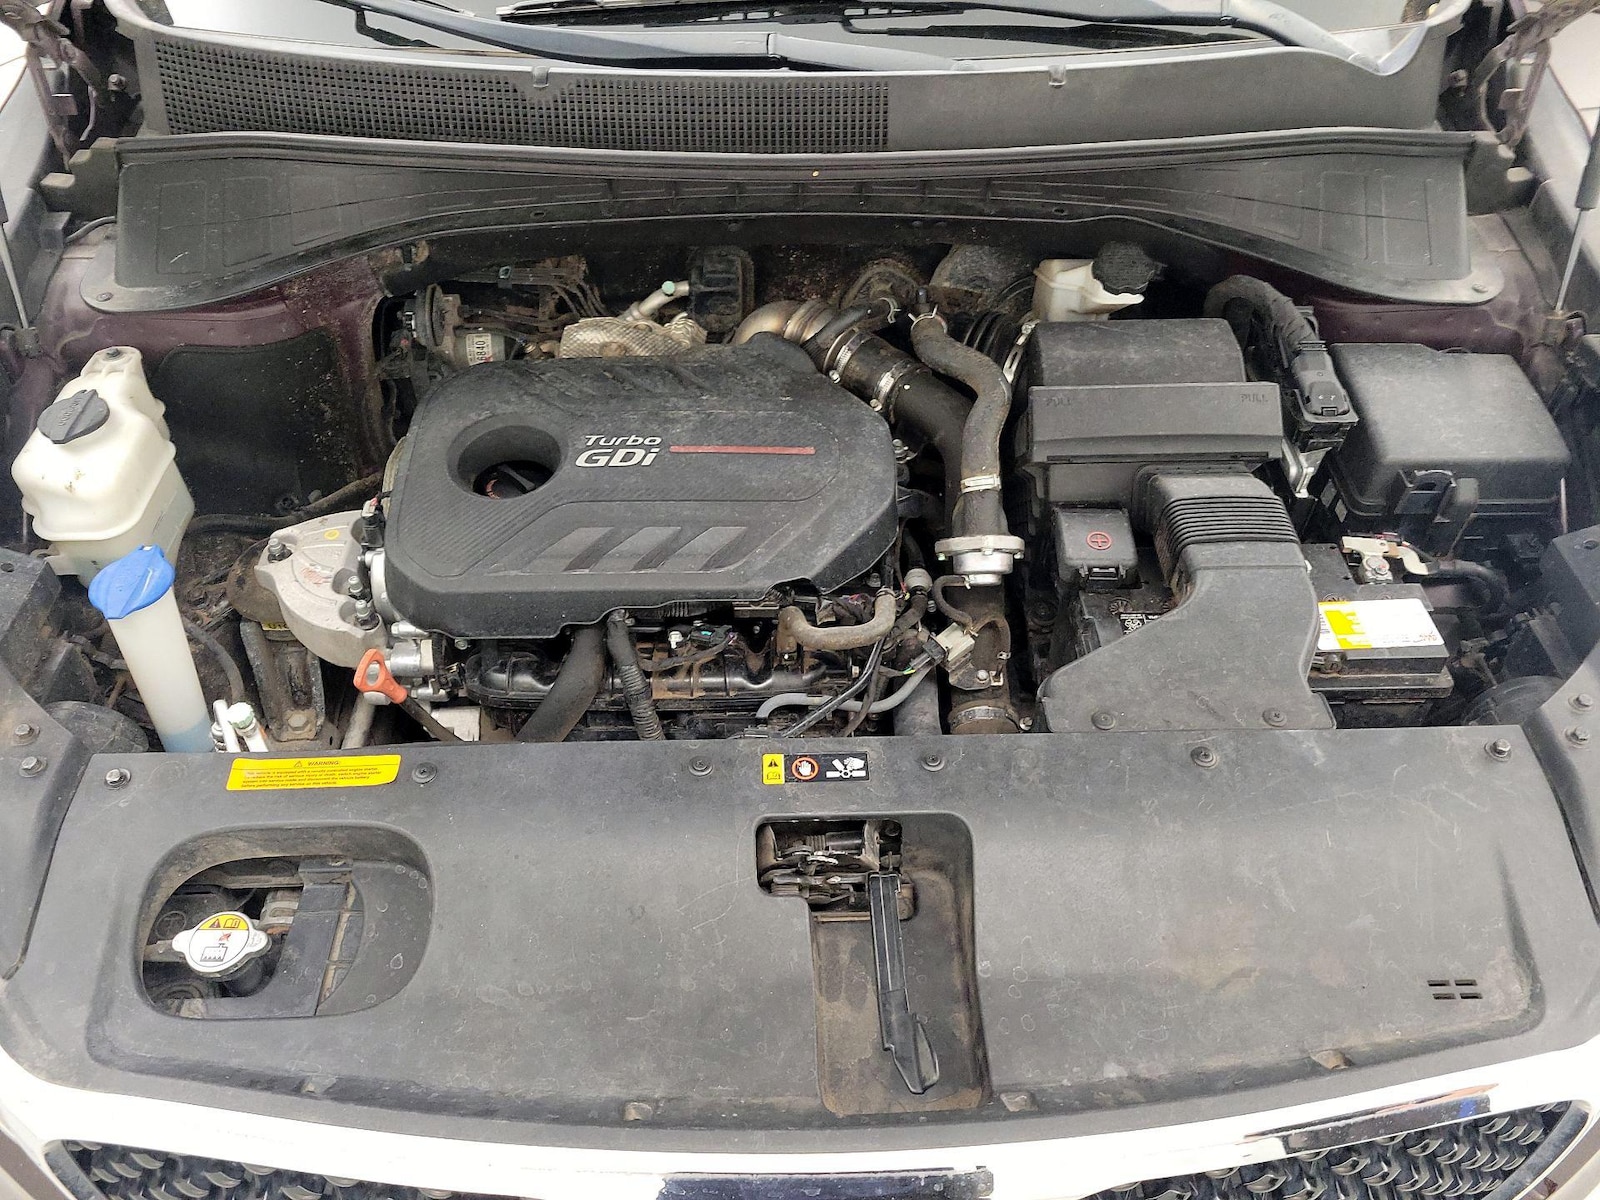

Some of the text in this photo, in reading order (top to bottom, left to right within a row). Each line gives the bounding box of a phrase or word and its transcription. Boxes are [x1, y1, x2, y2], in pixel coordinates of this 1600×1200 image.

[1240, 393, 1269, 403] PULL
[585, 434, 662, 446] Turbo
[575, 447, 660, 467] GDi
